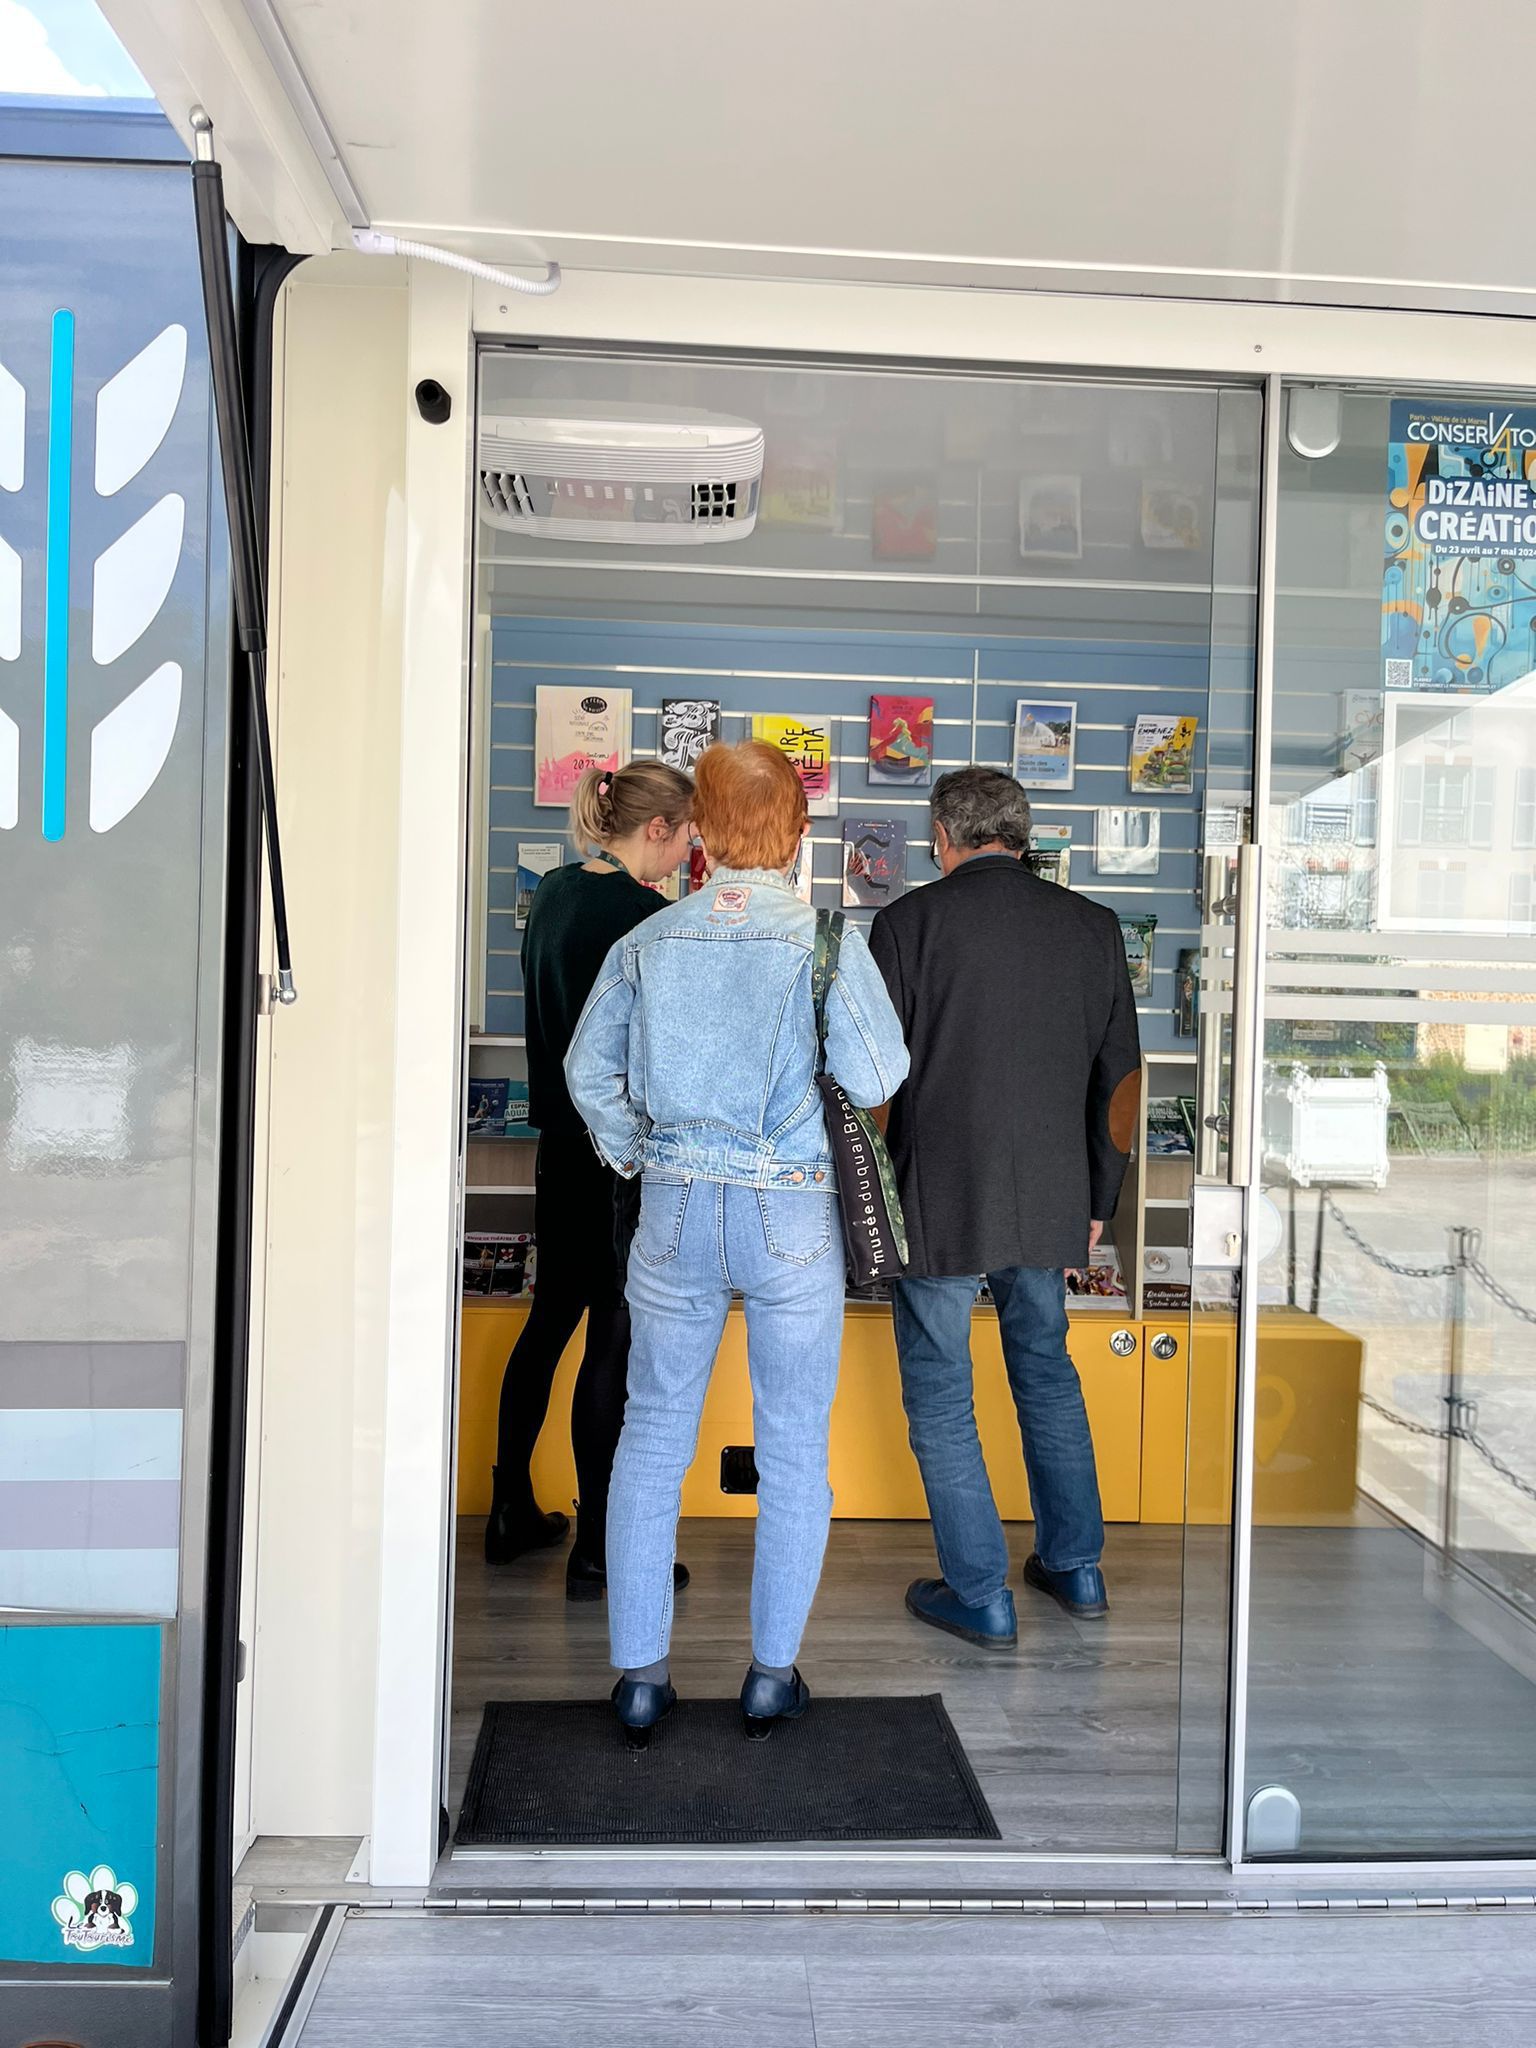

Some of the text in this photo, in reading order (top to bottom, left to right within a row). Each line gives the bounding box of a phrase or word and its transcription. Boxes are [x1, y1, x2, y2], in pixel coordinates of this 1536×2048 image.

[1409, 413, 1425, 421] Paris
[1432, 414, 1450, 422] Vallée
[1468, 417, 1488, 425] Marne
[1435, 545, 1447, 553] Du
[1448, 546, 1459, 554] 23
[1461, 546, 1480, 555] avril
[1482, 547, 1493, 555] au
[1494, 547, 1499, 555] 7
[1501, 547, 1516, 556] mai
[846, 1137, 870, 1177] quai
[858, 1180, 873, 1202] du
[862, 1204, 885, 1264] musée
[68, 1915, 84, 1929] Le
